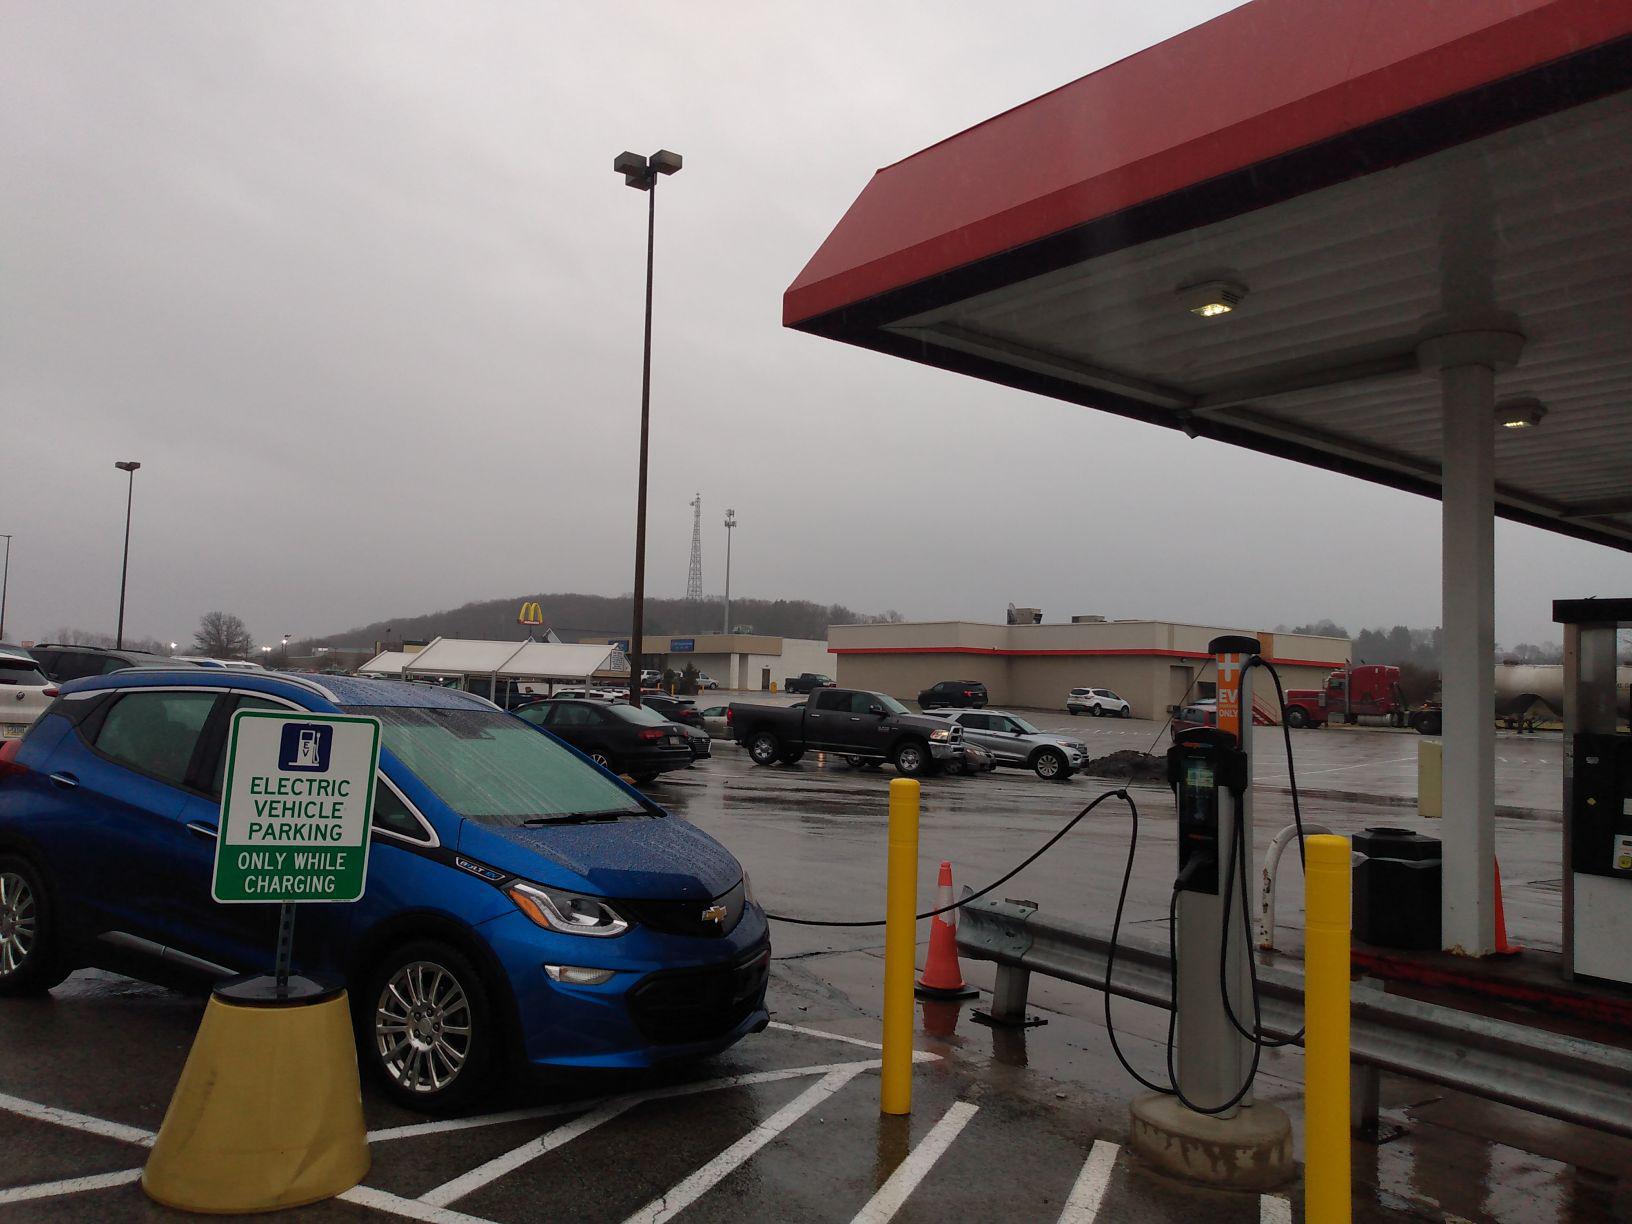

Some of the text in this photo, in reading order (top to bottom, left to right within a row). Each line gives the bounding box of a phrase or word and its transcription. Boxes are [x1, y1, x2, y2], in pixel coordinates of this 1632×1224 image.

[1218, 688, 1238, 703] EV
[1218, 709, 1238, 718] ONLY
[250, 777, 351, 797] ELECTRIC
[254, 800, 344, 819] VEHICLE
[248, 823, 343, 841] PARKING
[237, 852, 347, 870] ONLY WHILE
[244, 875, 336, 893] CHARGING
